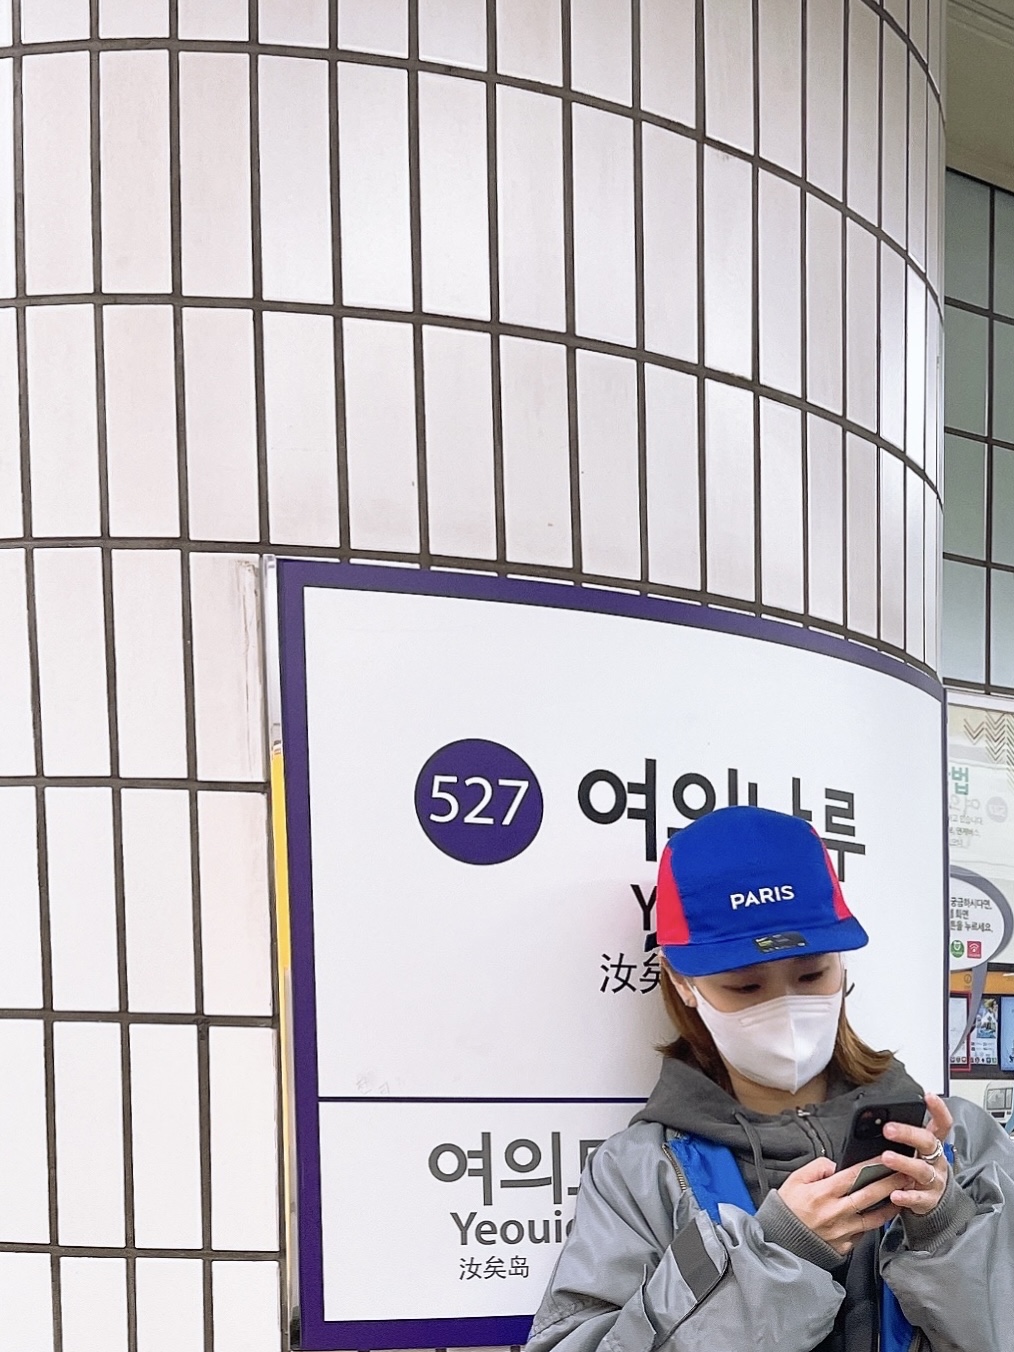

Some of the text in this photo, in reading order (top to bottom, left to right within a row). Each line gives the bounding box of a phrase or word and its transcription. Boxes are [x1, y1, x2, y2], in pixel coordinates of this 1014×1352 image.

[428, 773, 530, 827] 527
[730, 885, 795, 910] PARIS
[428, 1131, 607, 1206] 여의
[459, 1255, 530, 1281] 汝矣岛
